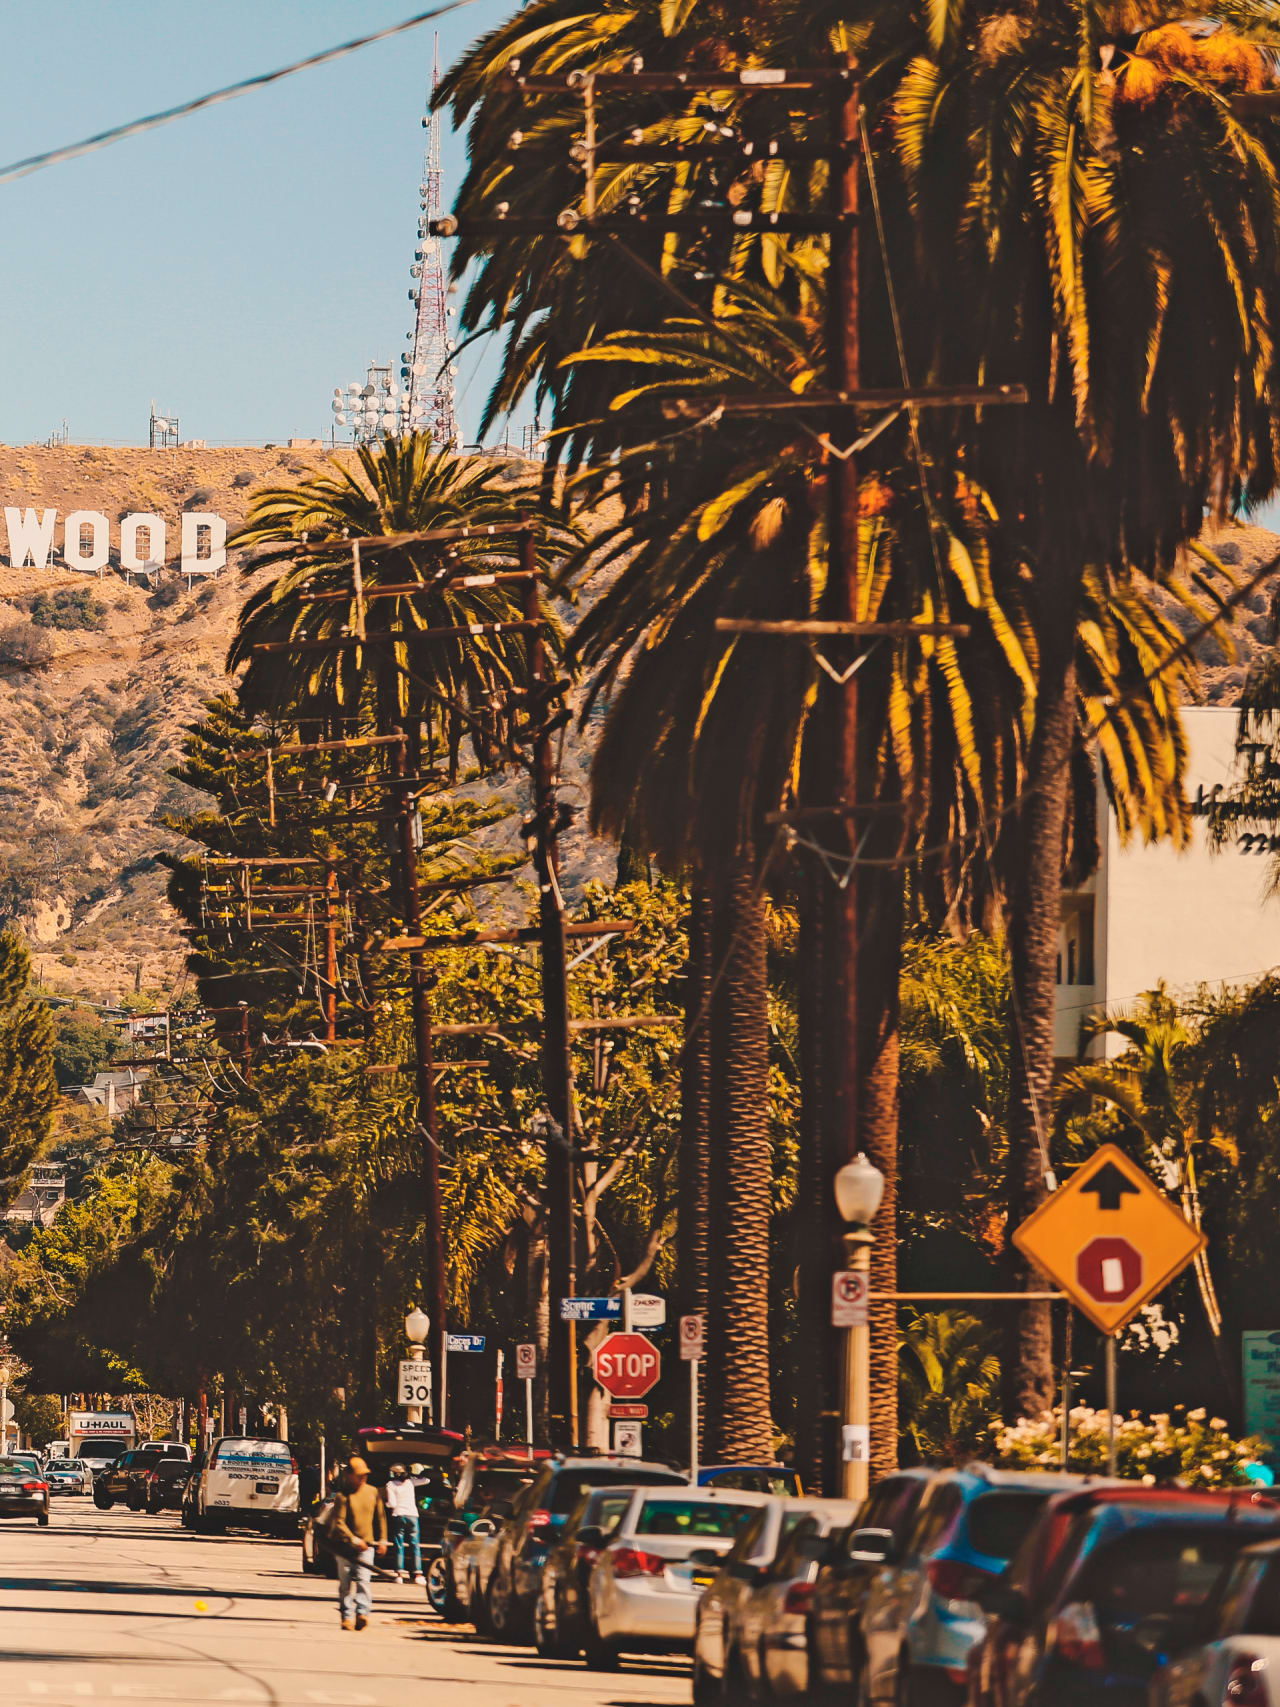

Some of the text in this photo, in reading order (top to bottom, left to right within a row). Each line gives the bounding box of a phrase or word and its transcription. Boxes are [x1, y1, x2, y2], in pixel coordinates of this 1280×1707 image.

[561, 1298, 596, 1311] Scenic
[402, 1364, 432, 1373] SPEED
[598, 1353, 656, 1378] STOP
[403, 1384, 429, 1401] 30
[80, 1421, 127, 1429] U-HAUL
